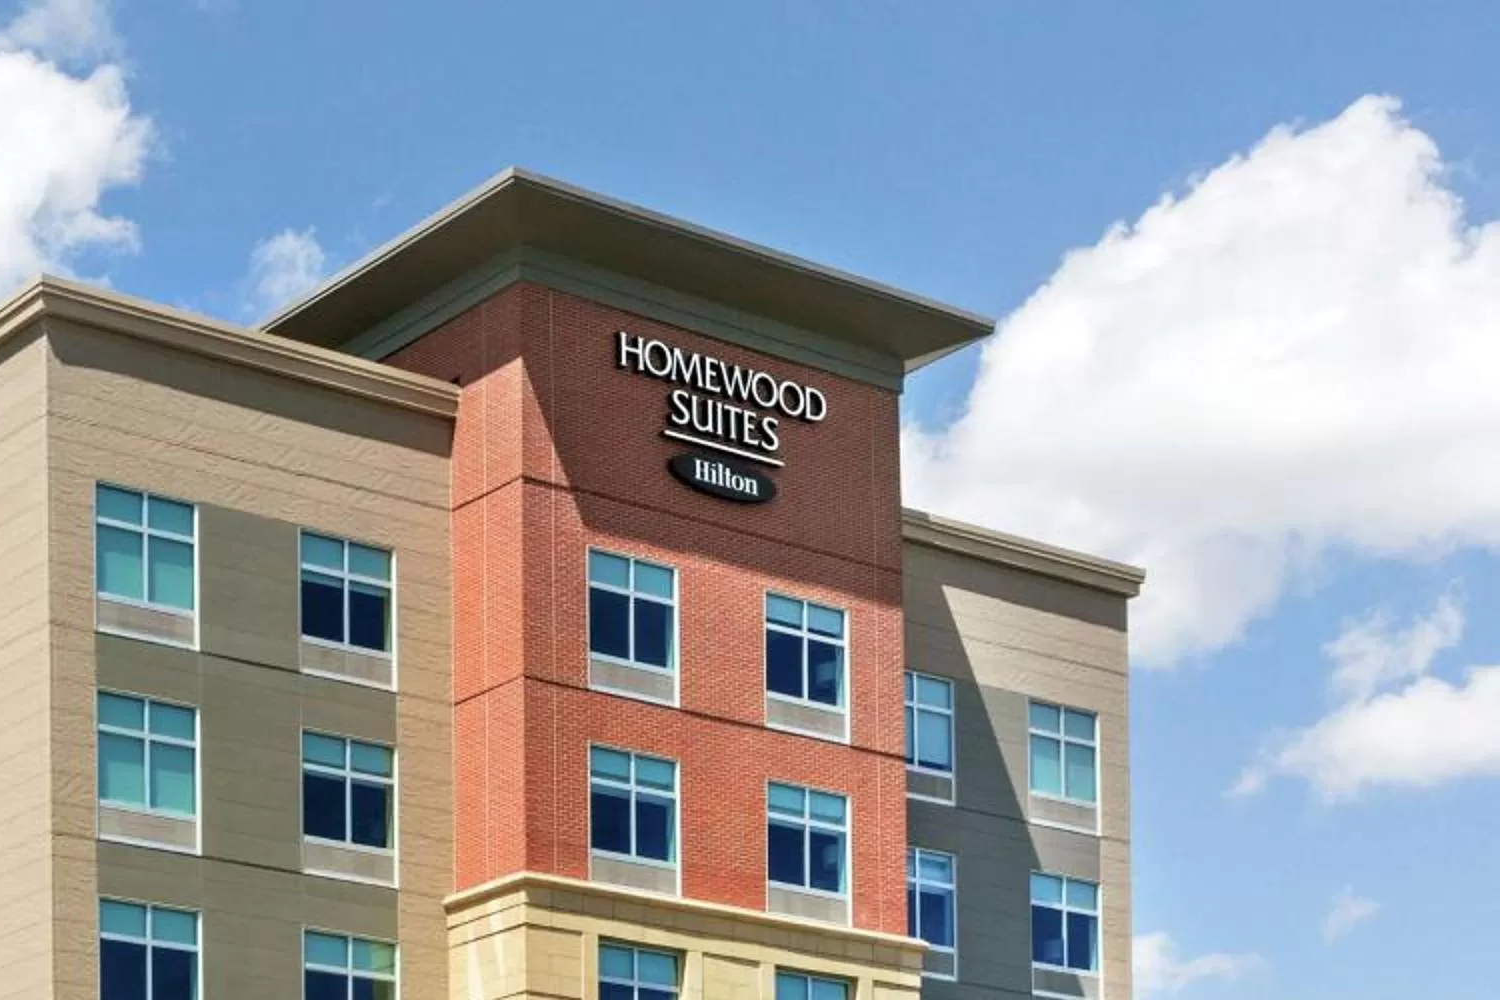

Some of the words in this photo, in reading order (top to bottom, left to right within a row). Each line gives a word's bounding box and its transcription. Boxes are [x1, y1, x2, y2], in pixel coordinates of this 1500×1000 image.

[618, 331, 828, 421] HOMEWOOD
[671, 389, 779, 451] SUITES
[693, 458, 760, 496] Hilton
